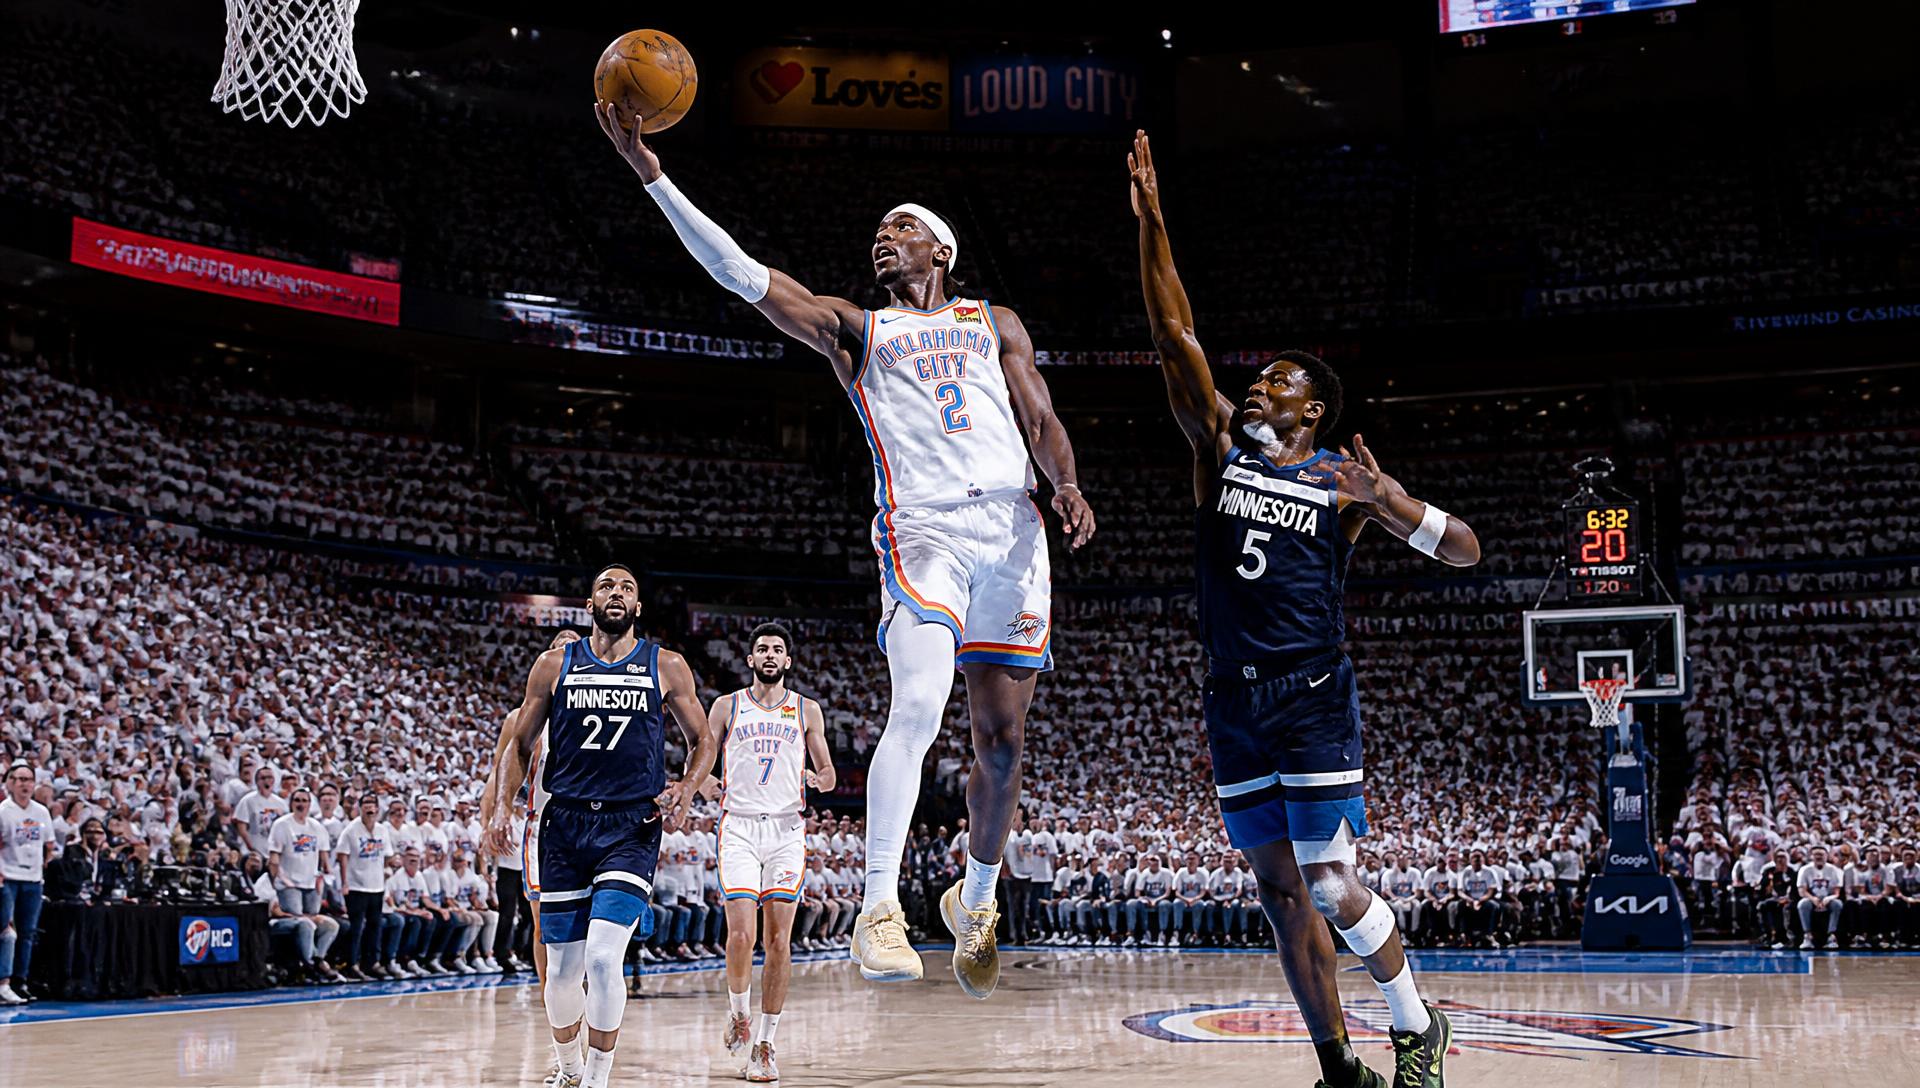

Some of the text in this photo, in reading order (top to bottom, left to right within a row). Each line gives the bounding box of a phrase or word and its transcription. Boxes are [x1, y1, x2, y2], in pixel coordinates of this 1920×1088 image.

[963, 64, 1139, 121] LOUD CITY
[876, 327, 992, 368] OKLAHOMA
[914, 352, 967, 381] CITY
[935, 380, 971, 434] 2
[1217, 485, 1318, 537] MINNESOTA
[1586, 508, 1629, 530] 6:32
[1235, 528, 1272, 580] 5
[1581, 529, 1626, 563] 20
[1588, 565, 1637, 576] TISSOT
[566, 688, 648, 712] MINNESOTA
[580, 714, 632, 751] 27
[735, 722, 799, 744] OKLAHOMA
[753, 739, 781, 753] CITY
[758, 756, 775, 785] 7
[1609, 854, 1649, 868] Google
[1594, 896, 1668, 914] KIA
